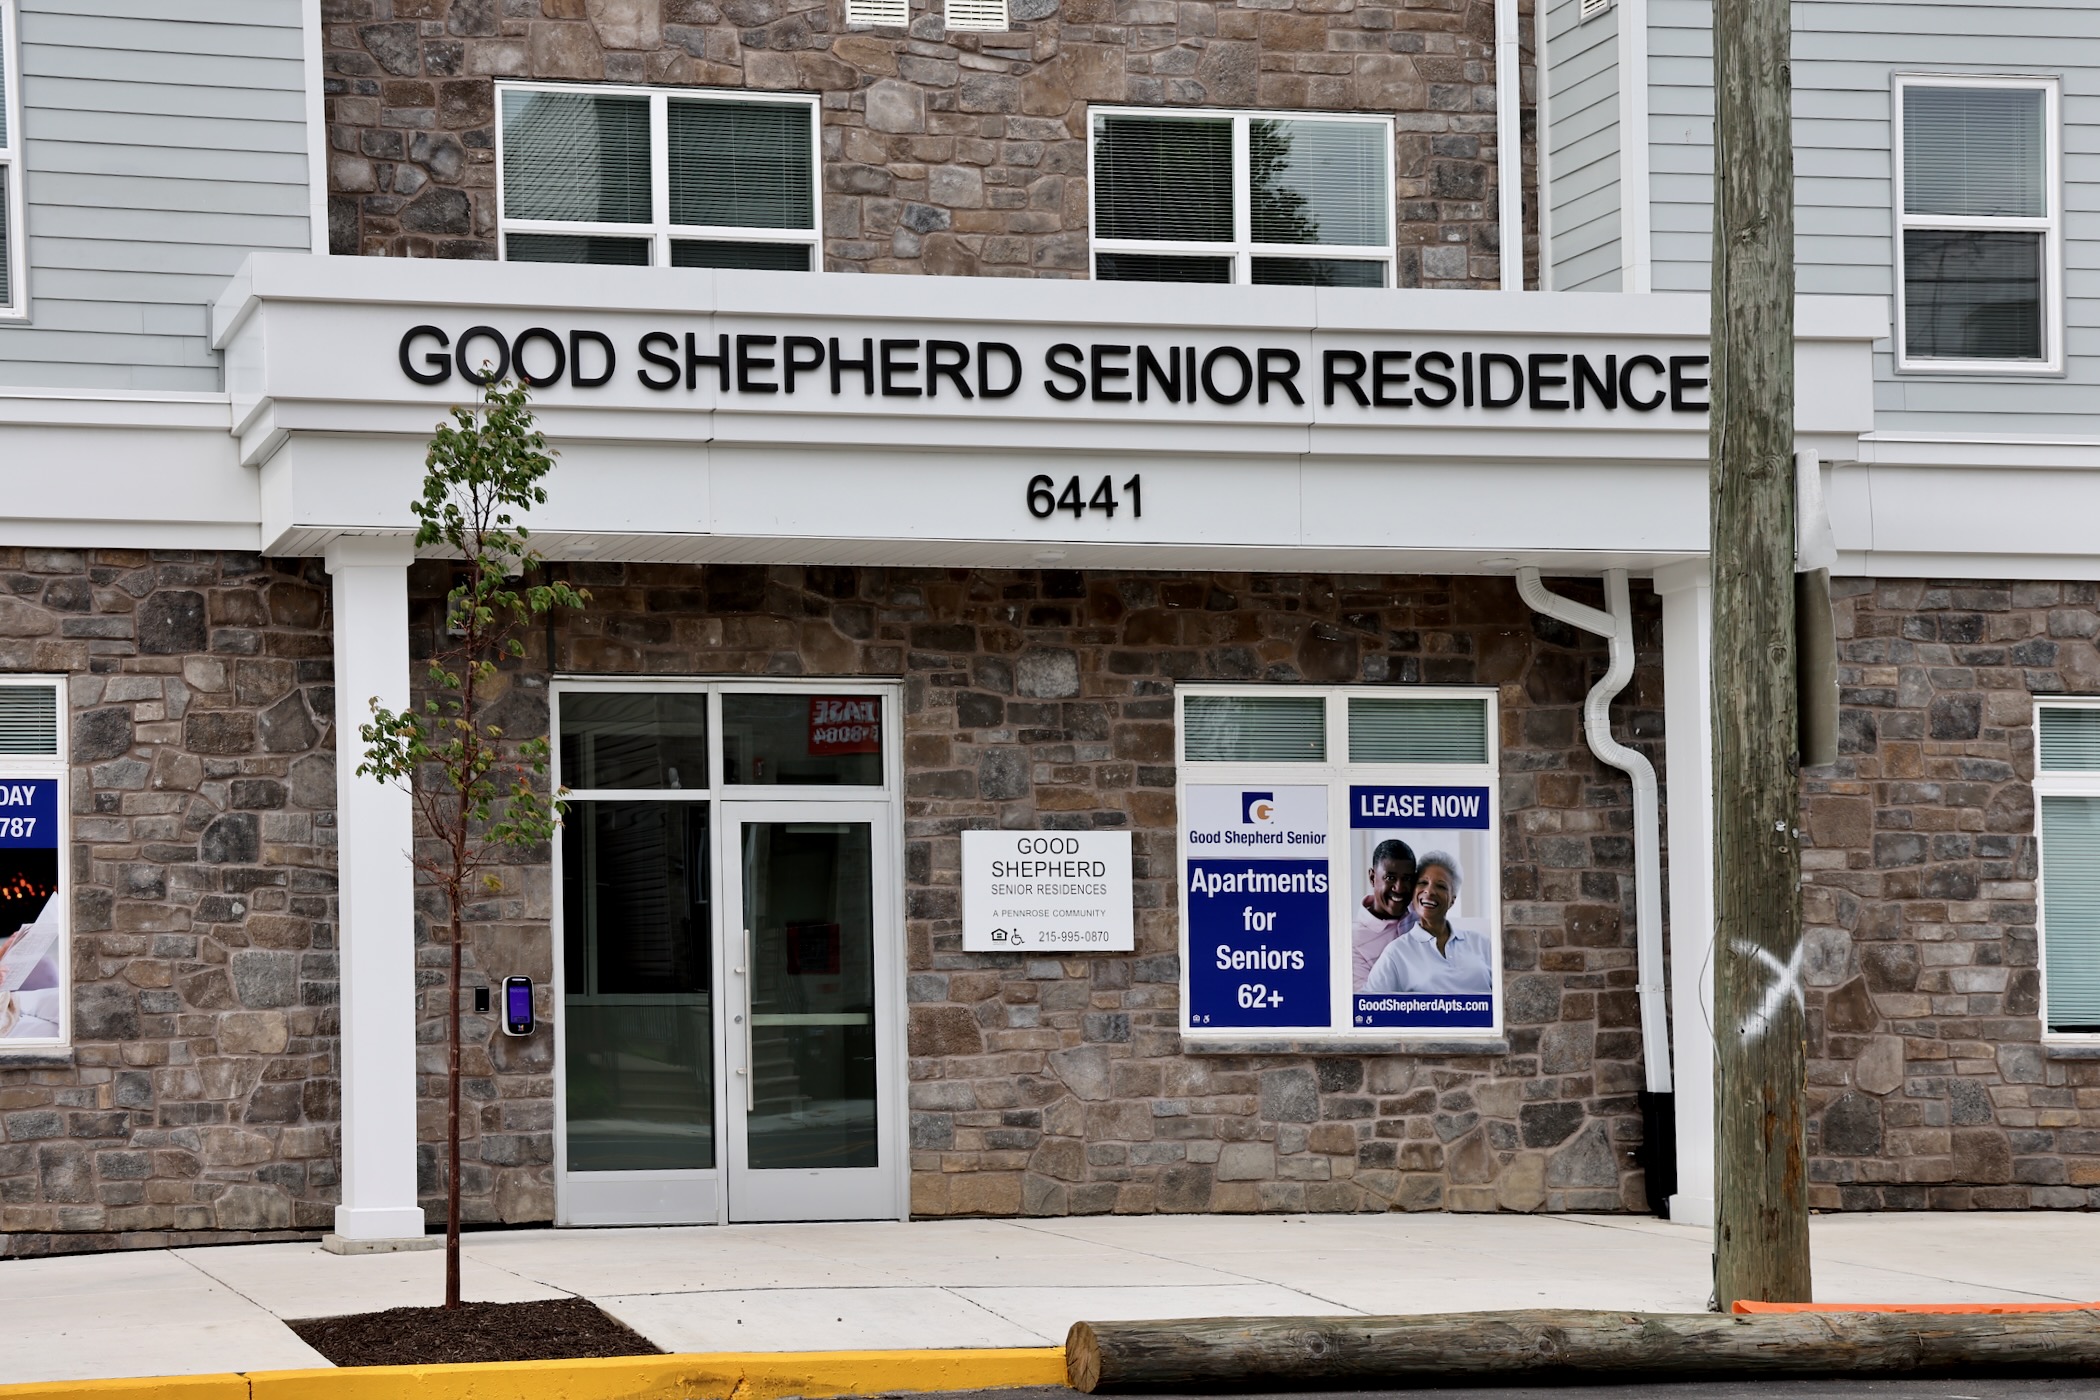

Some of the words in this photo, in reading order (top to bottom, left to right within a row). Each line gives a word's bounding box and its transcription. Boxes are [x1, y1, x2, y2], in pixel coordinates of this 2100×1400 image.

[399, 325, 615, 388] GOOD
[637, 331, 1022, 399] SHEPHERD
[1044, 343, 1304, 406] SENIOR
[1323, 350, 1710, 412] RESIDENCE
[1027, 474, 1141, 519] 6441
[1361, 794, 1426, 817] LEASE
[1431, 795, 1480, 818] NOW
[1017, 837, 1079, 855] GOOD
[1189, 830, 1221, 844] Good
[1224, 830, 1284, 847] Shepherd
[1287, 830, 1327, 845] Senior
[991, 860, 1106, 878] SHEPHERD
[991, 883, 1033, 895] SENIOR
[1037, 883, 1107, 895] RESIDENCES
[1190, 867, 1328, 898] Apartments
[992, 909, 999, 918] A
[1001, 909, 1050, 918] PENNROSE
[1052, 909, 1106, 918] COMMUNITY
[1242, 905, 1277, 932] for
[1038, 930, 1110, 943] 215-995-0870
[1216, 944, 1305, 970] Seniors
[1237, 983, 1284, 1009] 62+
[1358, 998, 1489, 1013] GoodShepherdApts.com
